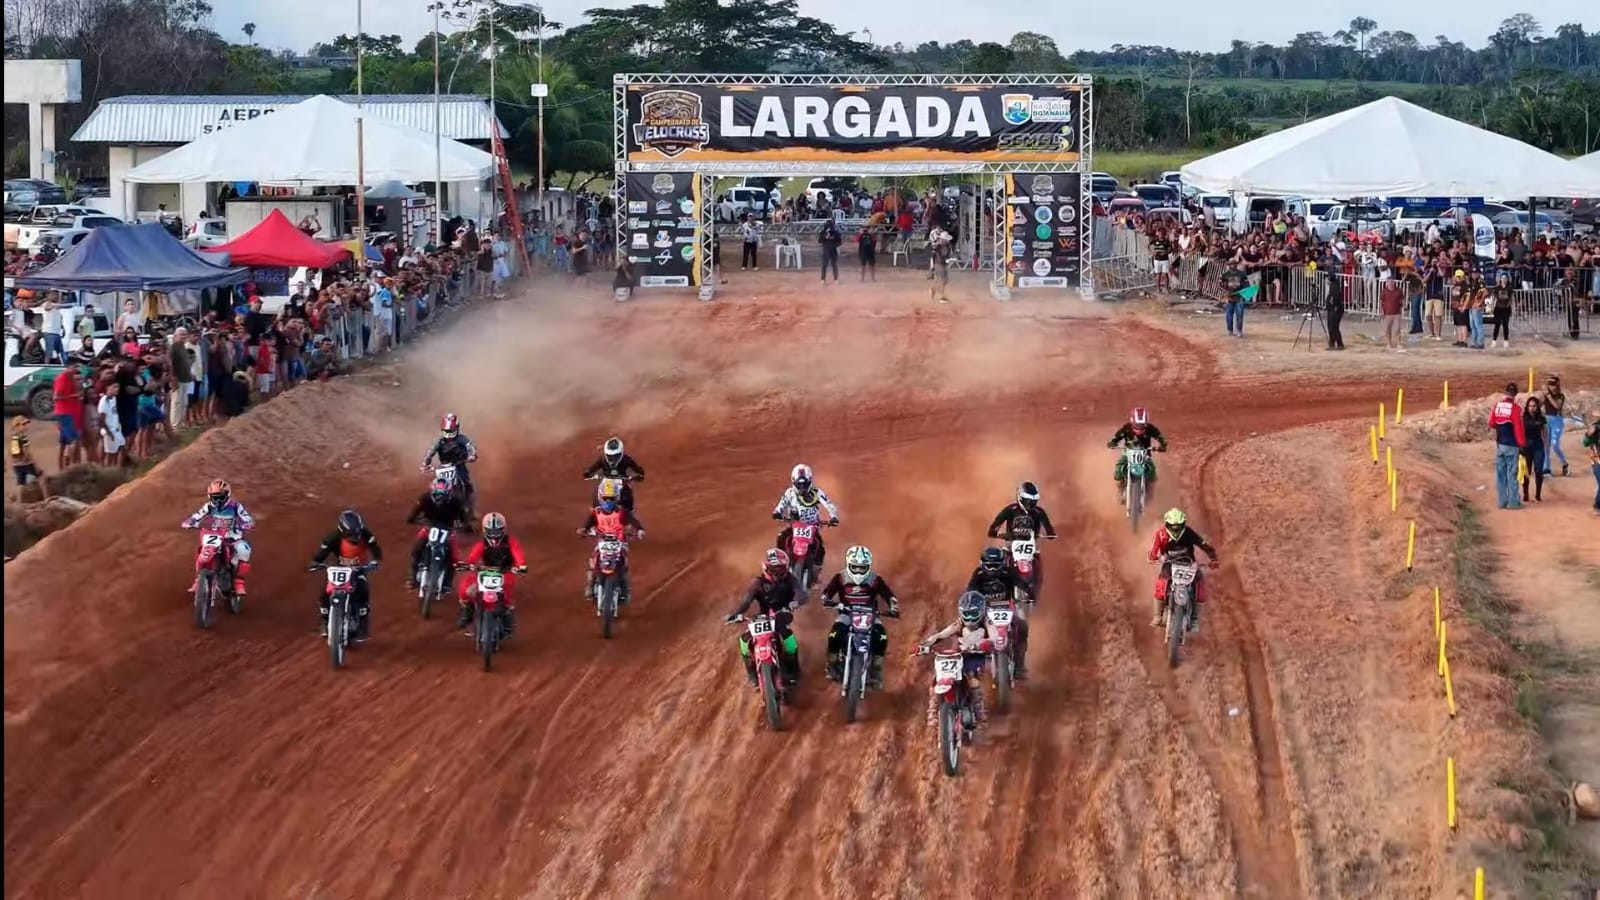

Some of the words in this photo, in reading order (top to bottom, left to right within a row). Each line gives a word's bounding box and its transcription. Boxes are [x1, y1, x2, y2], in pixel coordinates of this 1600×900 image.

[719, 95, 991, 137] LARGADA
[637, 125, 707, 141] VELOCROSS
[206, 535, 219, 545] 2
[428, 526, 449, 544] 07
[1014, 543, 1034, 555] 46
[332, 571, 347, 583] 18
[993, 612, 1009, 621] 22
[753, 620, 772, 634] 68
[941, 660, 958, 672] 27
